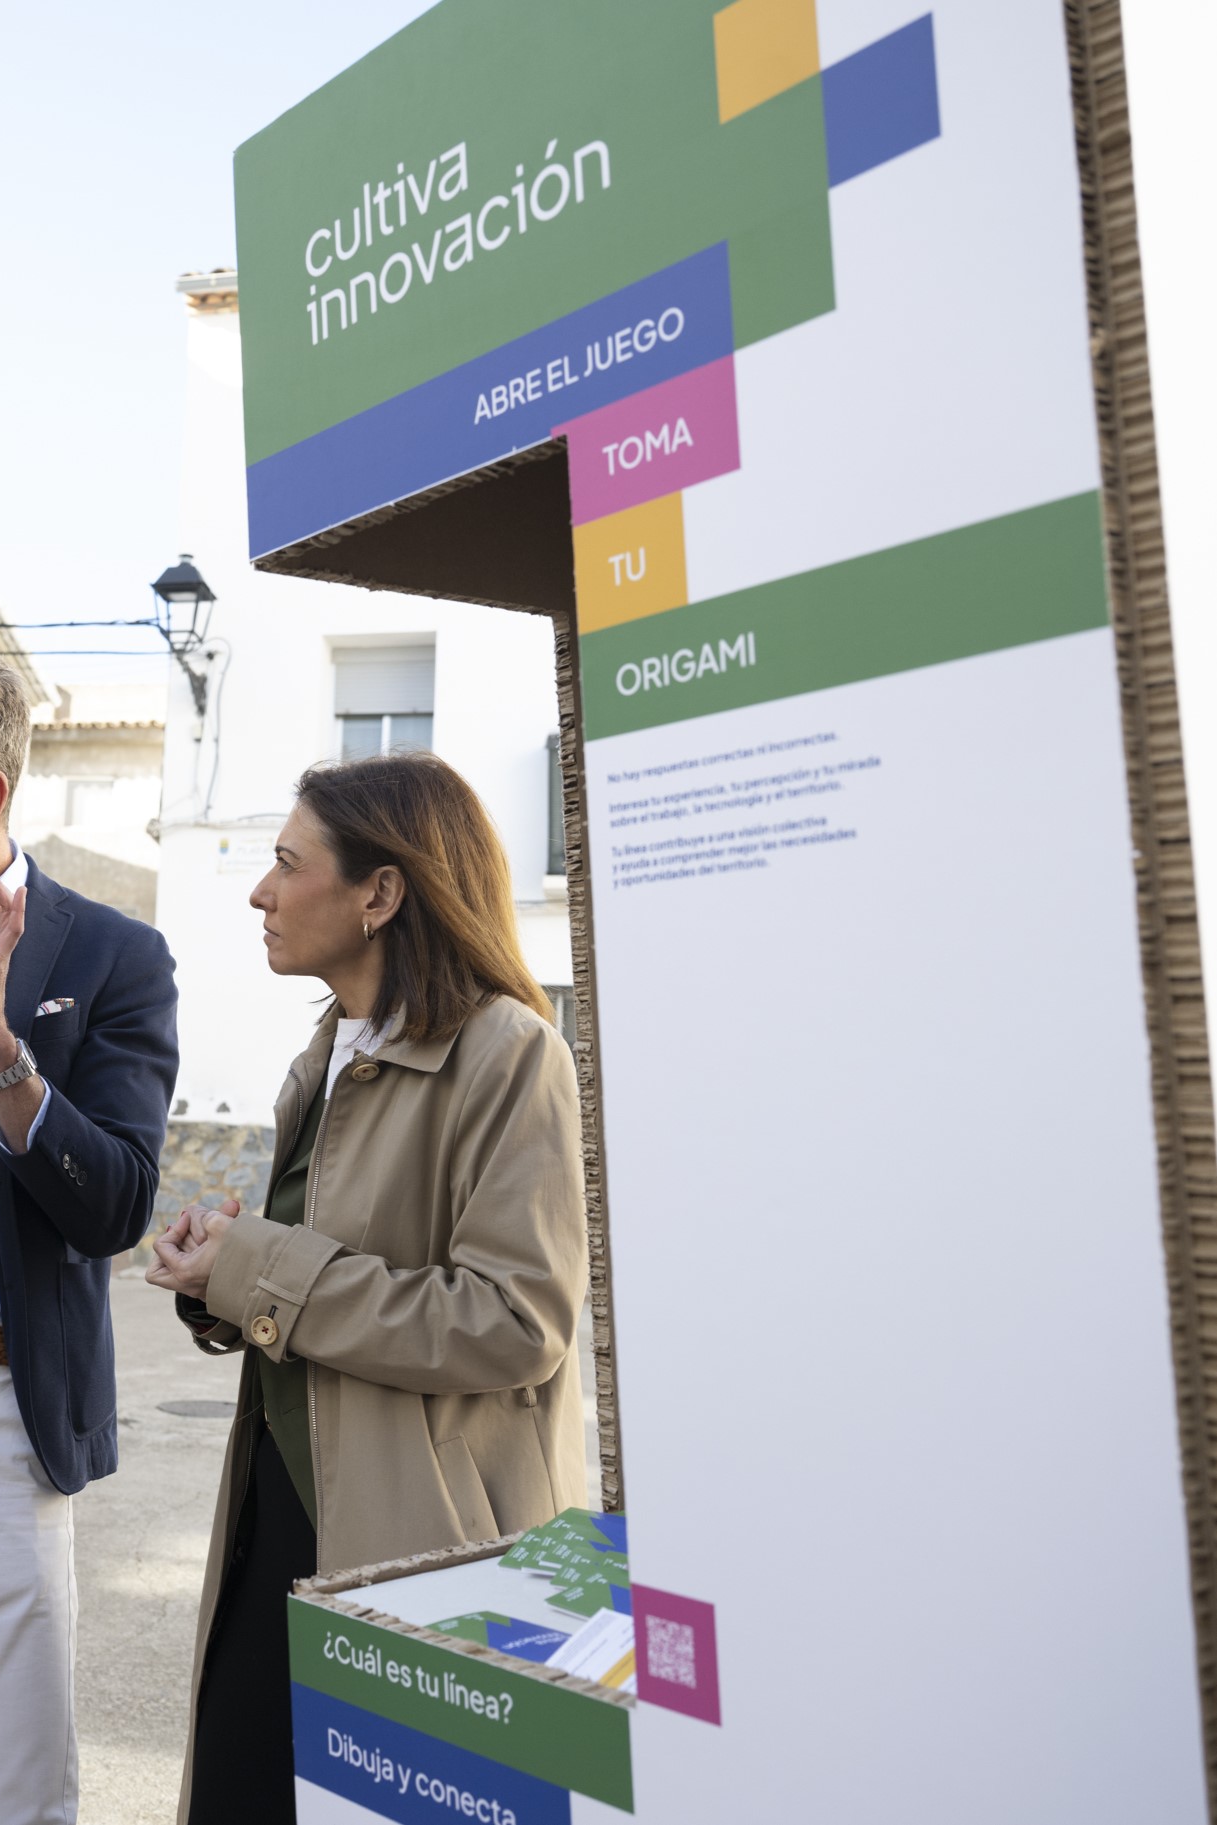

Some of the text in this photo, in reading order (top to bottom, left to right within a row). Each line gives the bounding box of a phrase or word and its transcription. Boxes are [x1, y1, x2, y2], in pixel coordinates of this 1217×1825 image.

[305, 141, 469, 277] cultiva
[305, 138, 612, 345] innovación
[473, 306, 685, 425] ABRE EL JUEGO
[601, 417, 694, 476] TOMA
[608, 546, 647, 586] TU
[615, 631, 757, 696] ORIGAMI
[607, 773, 621, 784] No
[622, 769, 640, 782] hay
[642, 759, 699, 777] respuestas
[701, 747, 754, 767] correctas
[756, 745, 766, 755] ni
[609, 799, 649, 813] Interesa
[651, 796, 662, 806] tu
[731, 781, 742, 792] tu
[744, 767, 811, 791] percepción
[813, 769, 820, 780] y
[822, 764, 835, 775] tu
[837, 756, 881, 772] mirada
[610, 815, 638, 829] sobre
[640, 813, 649, 823] el
[693, 803, 703, 814] la
[704, 793, 763, 812] tecnología
[775, 789, 784, 800] el
[611, 846, 623, 858] Tu
[650, 833, 705, 852] contribuye
[716, 830, 736, 842] una
[738, 825, 770, 838] visión
[772, 815, 828, 834] colectiva
[620, 857, 650, 873] ayuda
[661, 847, 725, 865] comprender
[728, 842, 760, 858] mejor
[762, 839, 778, 851] las
[780, 827, 857, 848] necesidades
[620, 866, 697, 887] oportunidades
[698, 862, 715, 877] del
[323, 1631, 514, 1724] ¿Cuál es tu línea?
[327, 1728, 517, 1825] Dibuja y conecta
